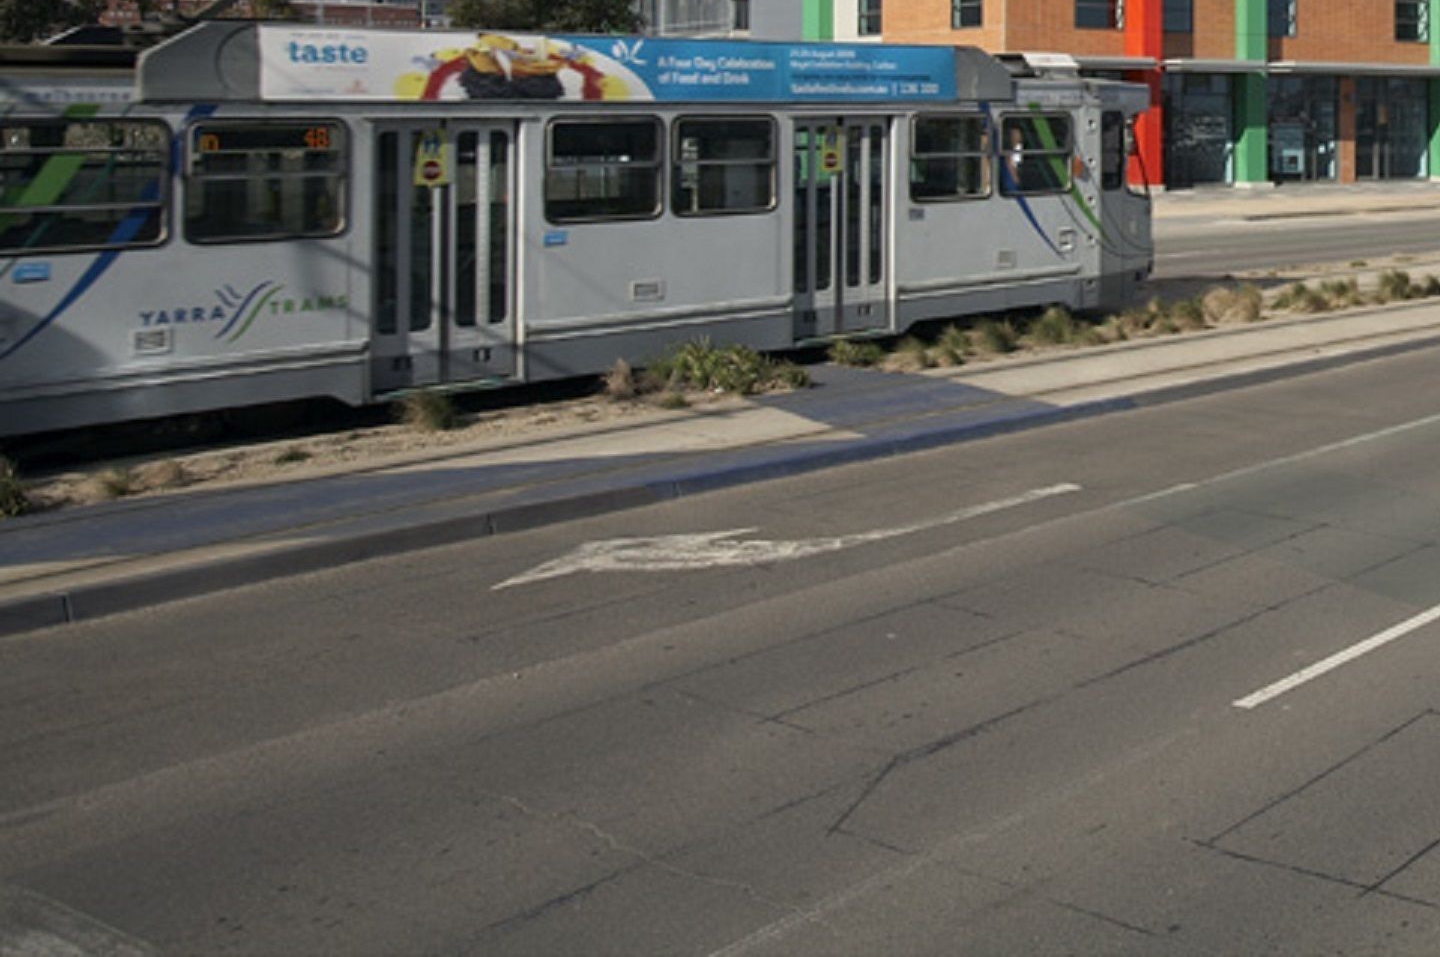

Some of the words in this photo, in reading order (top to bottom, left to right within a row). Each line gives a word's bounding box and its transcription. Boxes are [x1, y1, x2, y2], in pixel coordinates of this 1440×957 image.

[287, 41, 368, 64] taste
[694, 56, 716, 72] Day
[718, 56, 776, 70] Celebration
[658, 72, 670, 84] of
[672, 72, 699, 84] Food
[702, 72, 722, 84] and
[723, 72, 750, 84] Drink
[304, 127, 329, 148] 48
[139, 305, 226, 326] YARRA
[269, 295, 348, 315] TRAMS
